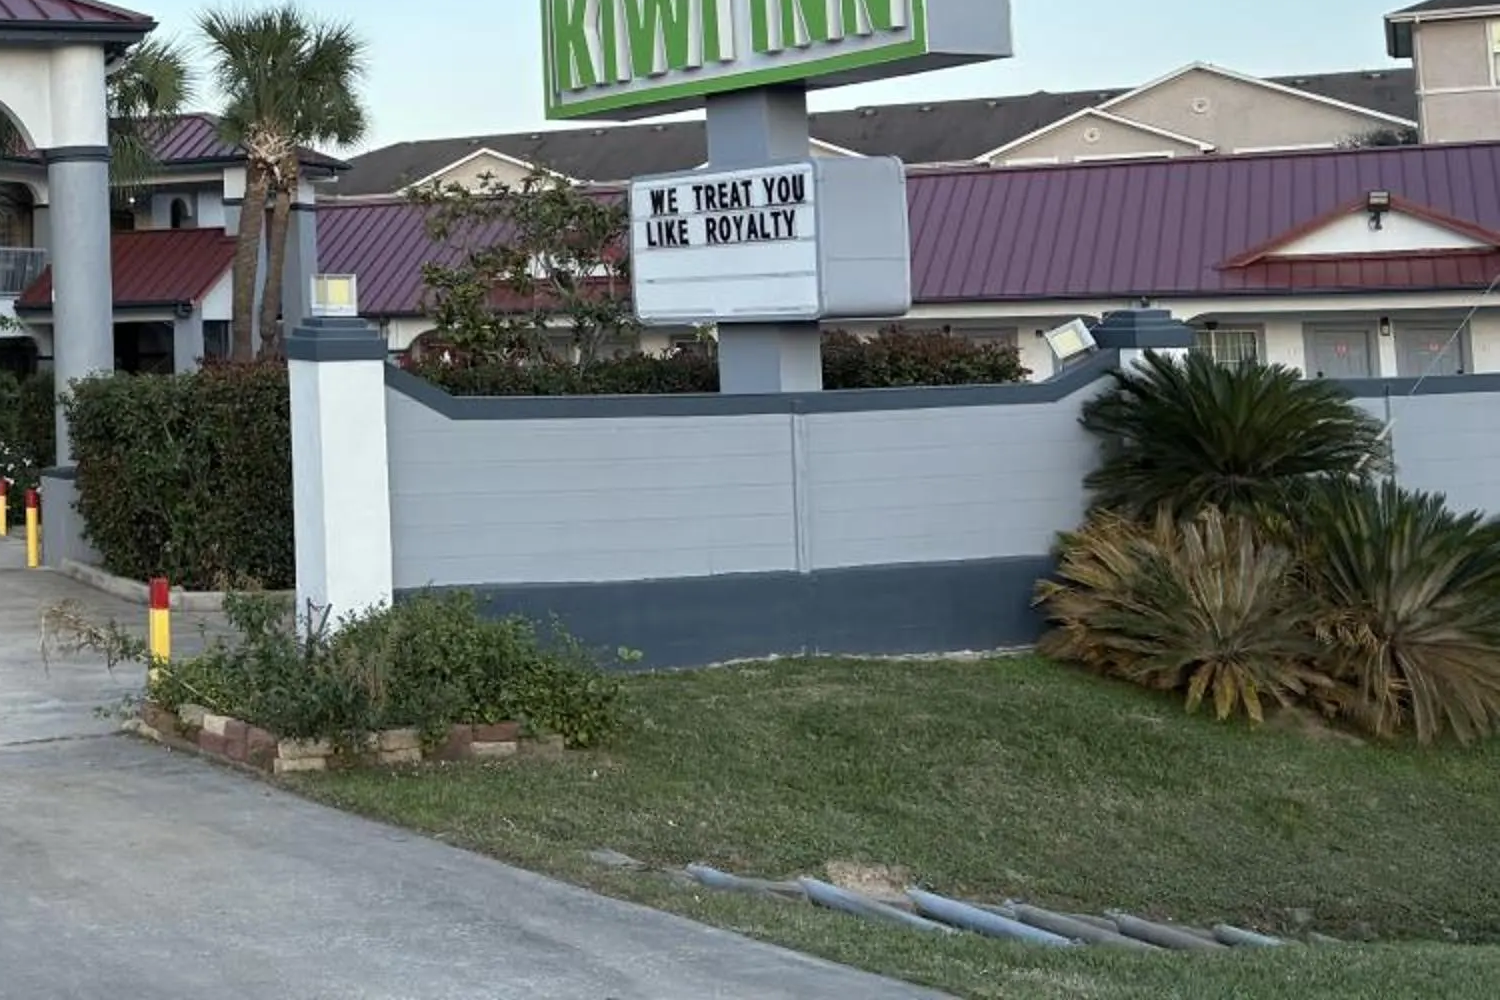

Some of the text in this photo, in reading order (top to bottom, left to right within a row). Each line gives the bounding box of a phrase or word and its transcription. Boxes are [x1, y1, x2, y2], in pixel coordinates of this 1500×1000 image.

[650, 173, 806, 215] WE TREAT YOU
[646, 209, 796, 247] LIKE ROYALTY
